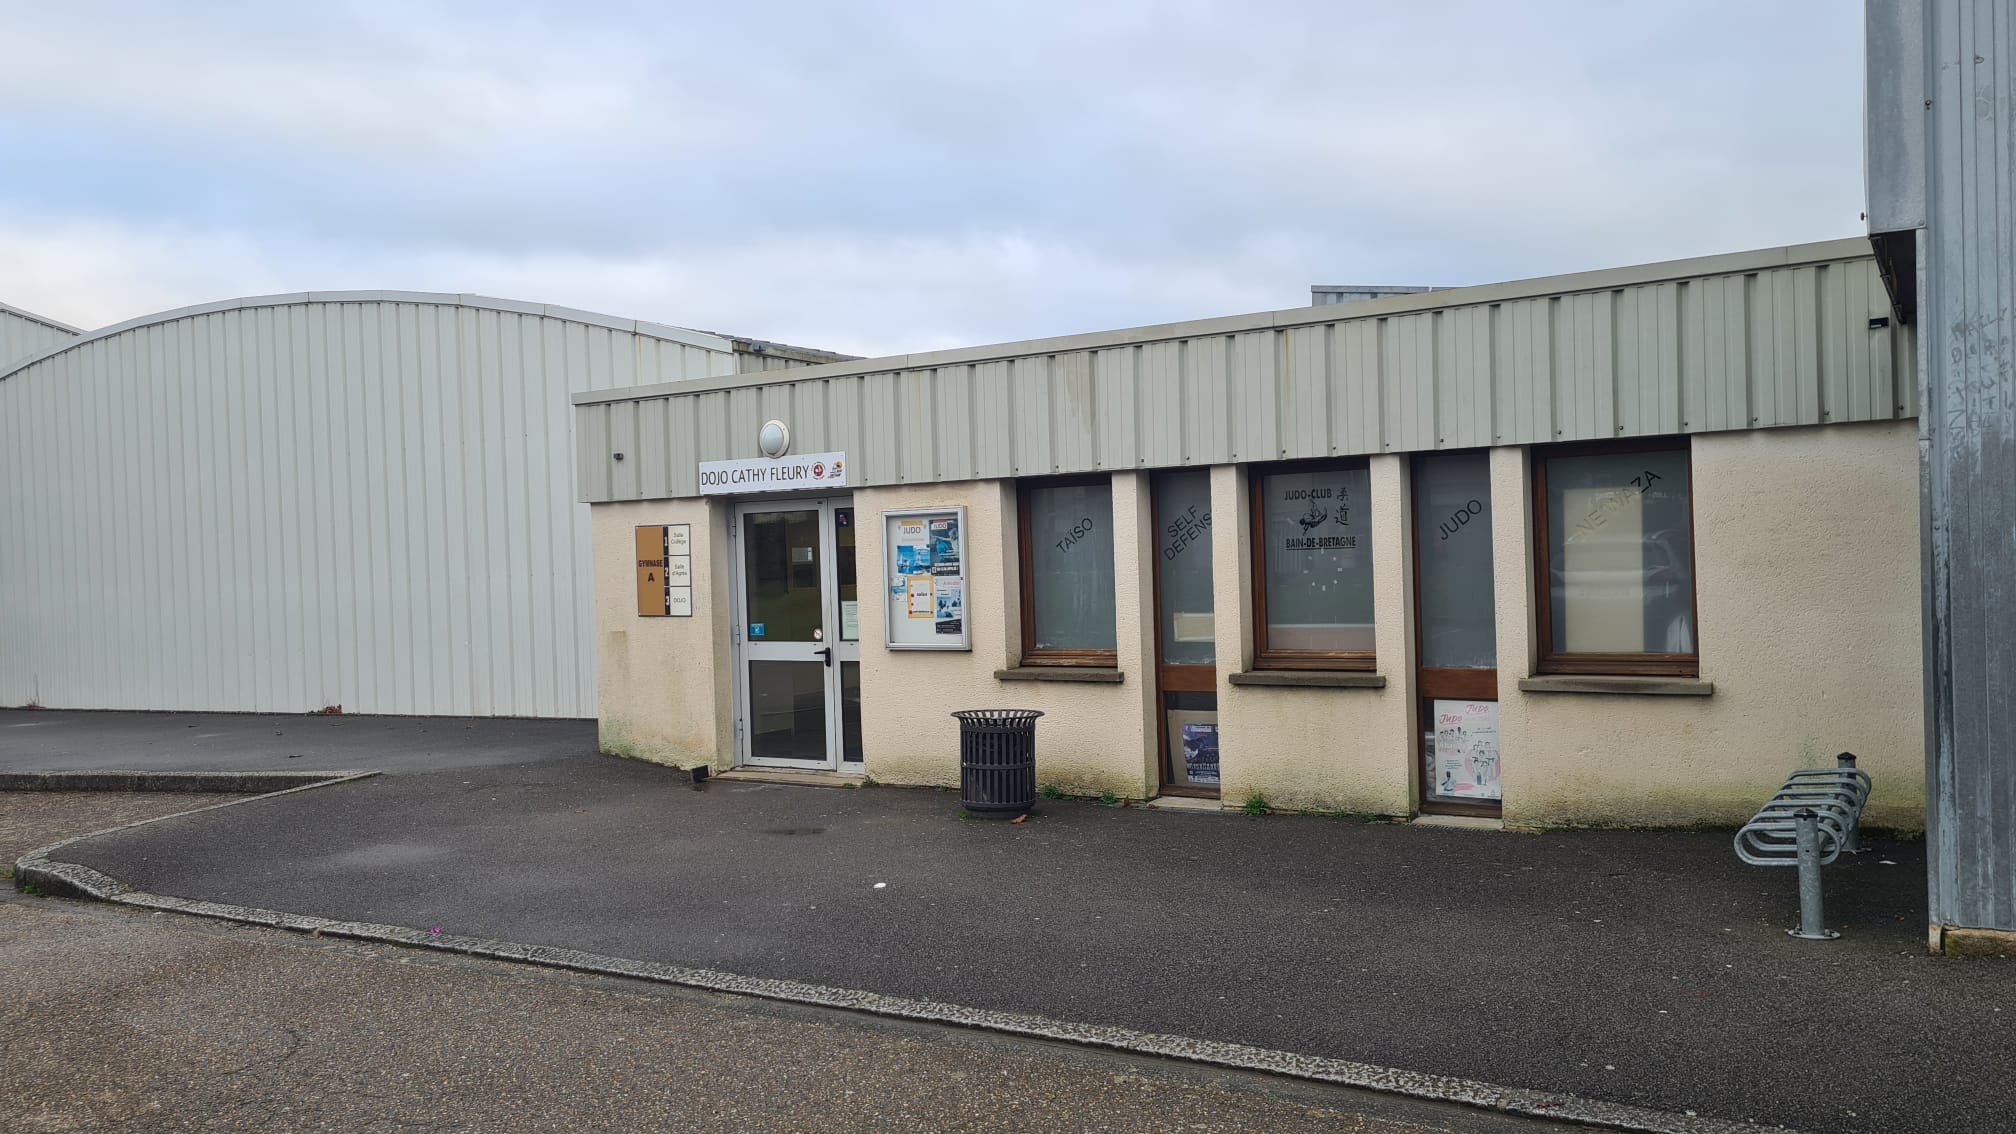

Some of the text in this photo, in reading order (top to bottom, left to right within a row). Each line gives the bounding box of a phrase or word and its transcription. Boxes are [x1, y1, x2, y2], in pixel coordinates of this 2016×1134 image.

[701, 470, 729, 486] DOJO
[731, 468, 767, 484] CATHY
[770, 465, 810, 481] FLEURY
[1284, 488, 1332, 501] JUDO-CLUB
[1167, 505, 1198, 538] SELF
[1439, 499, 1482, 541] JUDO
[903, 526, 921, 534] JUDO
[1056, 517, 1093, 553] TAÏSO
[1163, 510, 1212, 561] DEFENS
[664, 536, 668, 547] 1
[1285, 535, 1357, 549] BAIN-DE-BRETAGNE
[638, 559, 663, 568] GYMNASE
[647, 572, 655, 582] A
[664, 567, 669, 577] 2
[665, 595, 670, 606] 3
